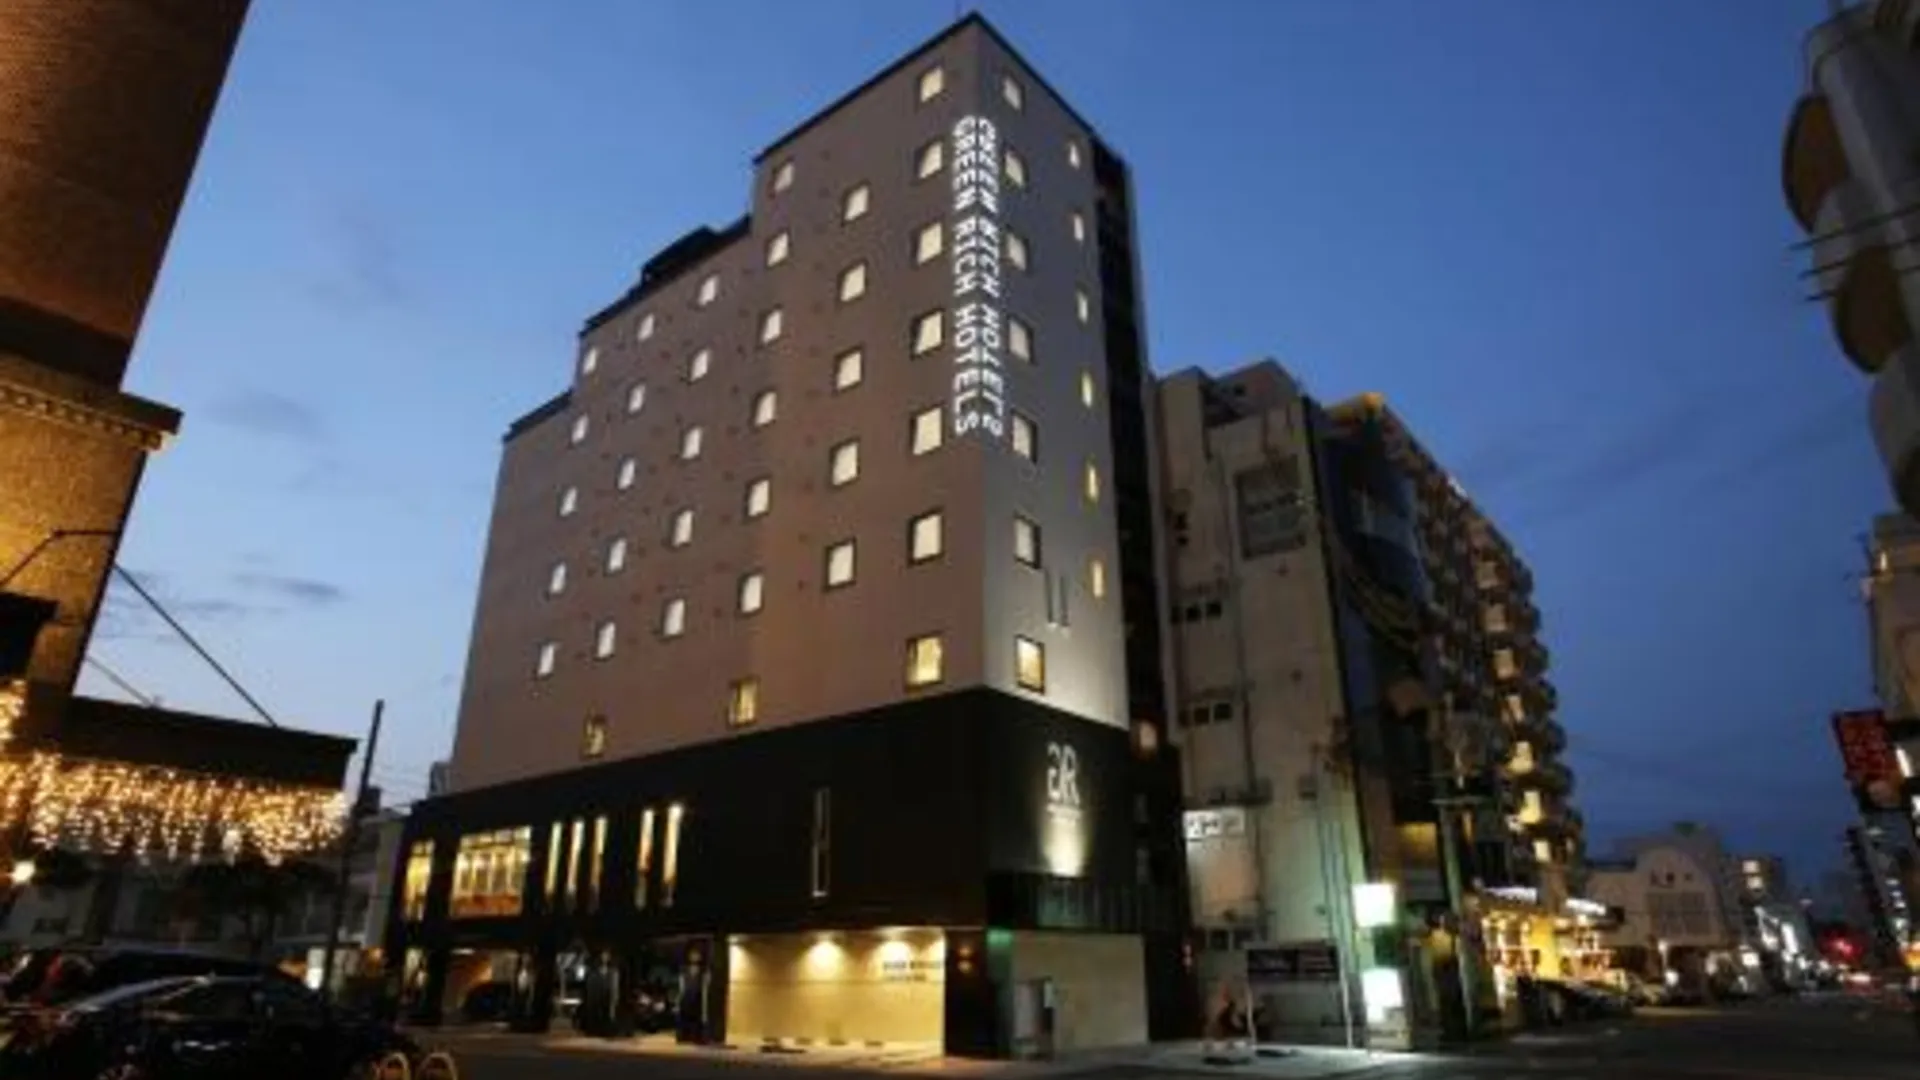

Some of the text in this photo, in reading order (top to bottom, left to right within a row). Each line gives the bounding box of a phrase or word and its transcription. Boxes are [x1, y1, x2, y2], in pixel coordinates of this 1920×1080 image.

[953, 115, 980, 436] GREEN RICH HOTELS
